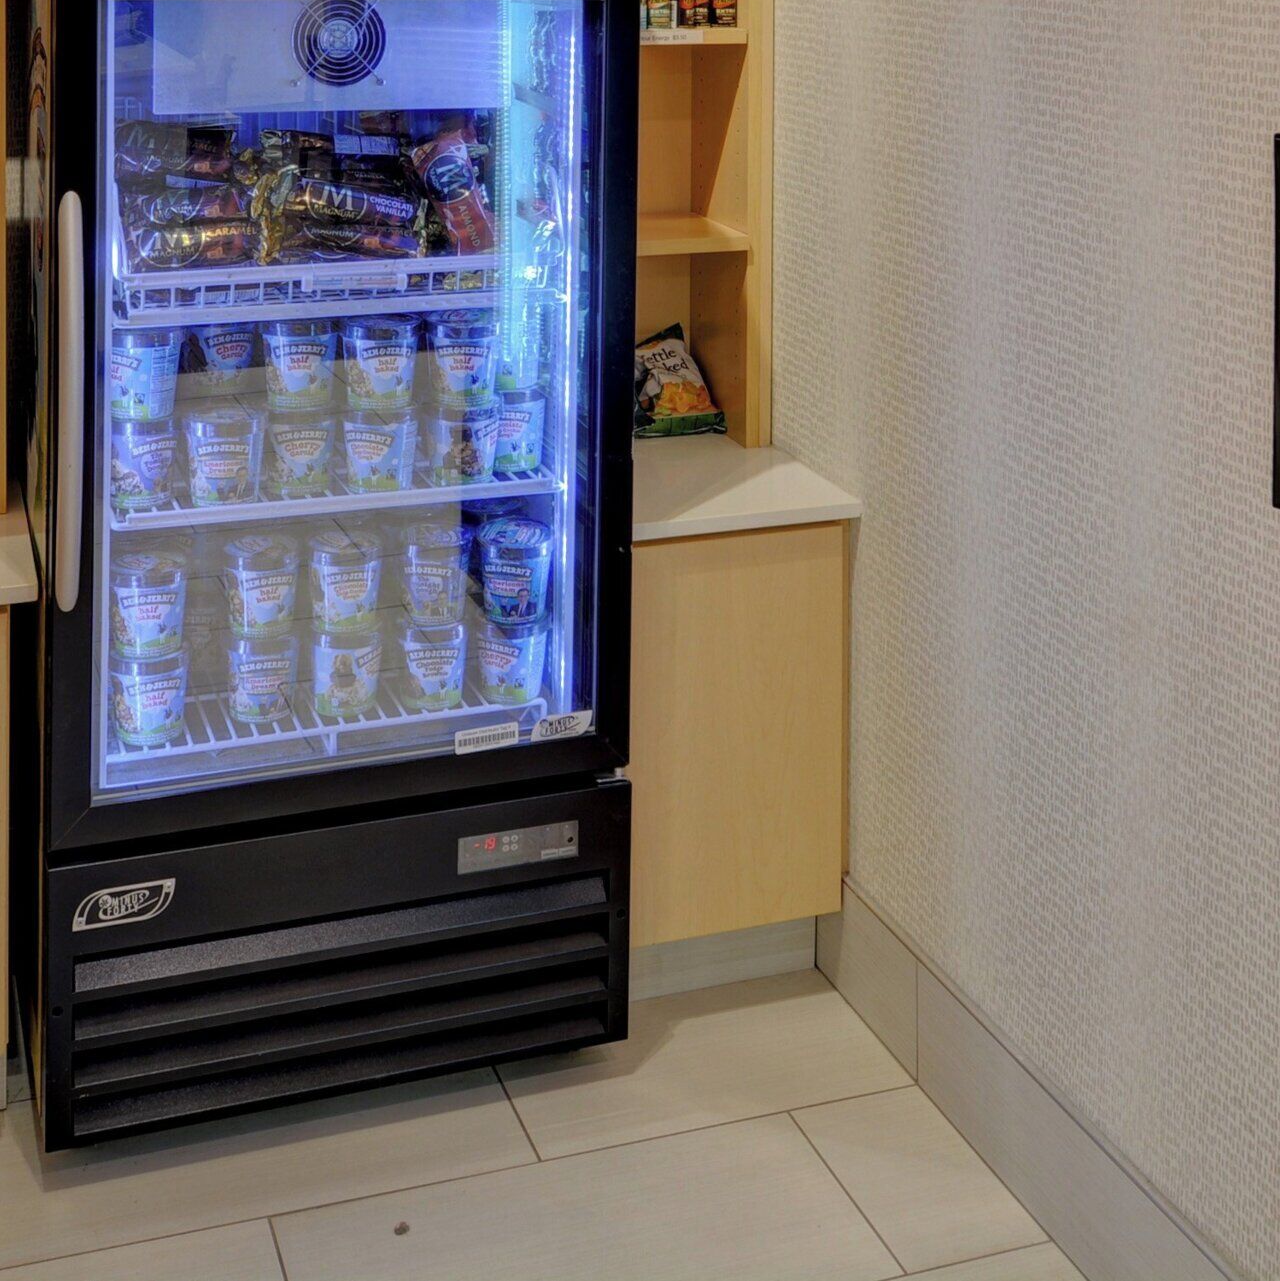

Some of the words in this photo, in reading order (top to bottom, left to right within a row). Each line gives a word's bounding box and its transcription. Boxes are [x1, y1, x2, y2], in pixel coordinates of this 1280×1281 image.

[370, 196, 414, 211] CHOCOLATE
[314, 204, 357, 219] MAGNUM
[375, 205, 408, 219] VANILLA
[205, 225, 257, 238] CARAMEL
[458, 205, 481, 247] ALMOND
[311, 229, 355, 239] MAGNUM
[150, 247, 195, 259] MAGNUM
[290, 355, 310, 365] half
[378, 357, 397, 366] half
[453, 356, 473, 366] half
[285, 442, 321, 453] Cherry
[259, 587, 279, 597] half
[138, 606, 159, 615] half
[145, 691, 166, 701] half
[111, 892, 145, 907] MINUS
[106, 903, 138, 917] FORTY
